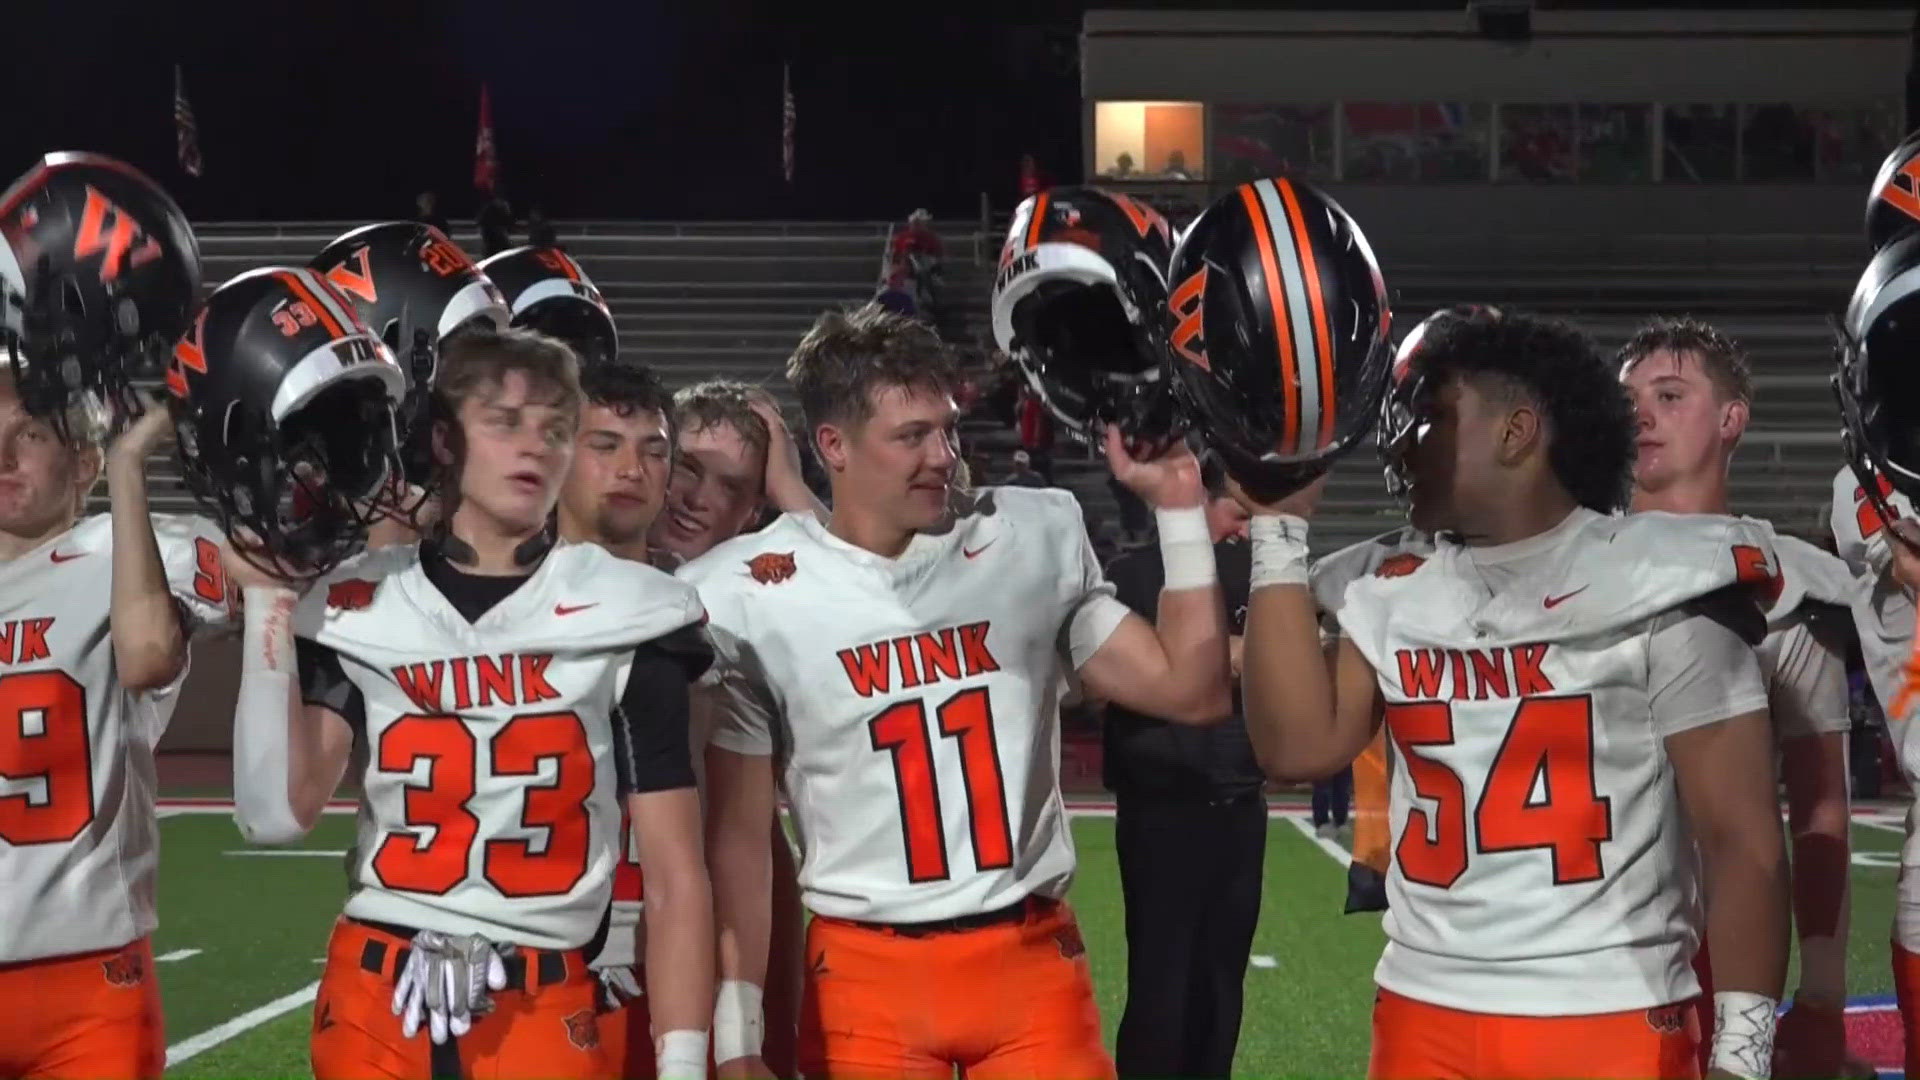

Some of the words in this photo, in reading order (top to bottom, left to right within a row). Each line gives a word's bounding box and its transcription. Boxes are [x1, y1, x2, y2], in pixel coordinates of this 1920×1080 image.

[74, 184, 163, 285] W
[272, 300, 317, 337] 33
[391, 653, 562, 713] WINK
[836, 620, 1001, 697] WINK
[1395, 642, 1555, 700] WINK
[371, 710, 595, 898] 33
[868, 685, 1014, 884] 11
[1384, 693, 1613, 890] 54
